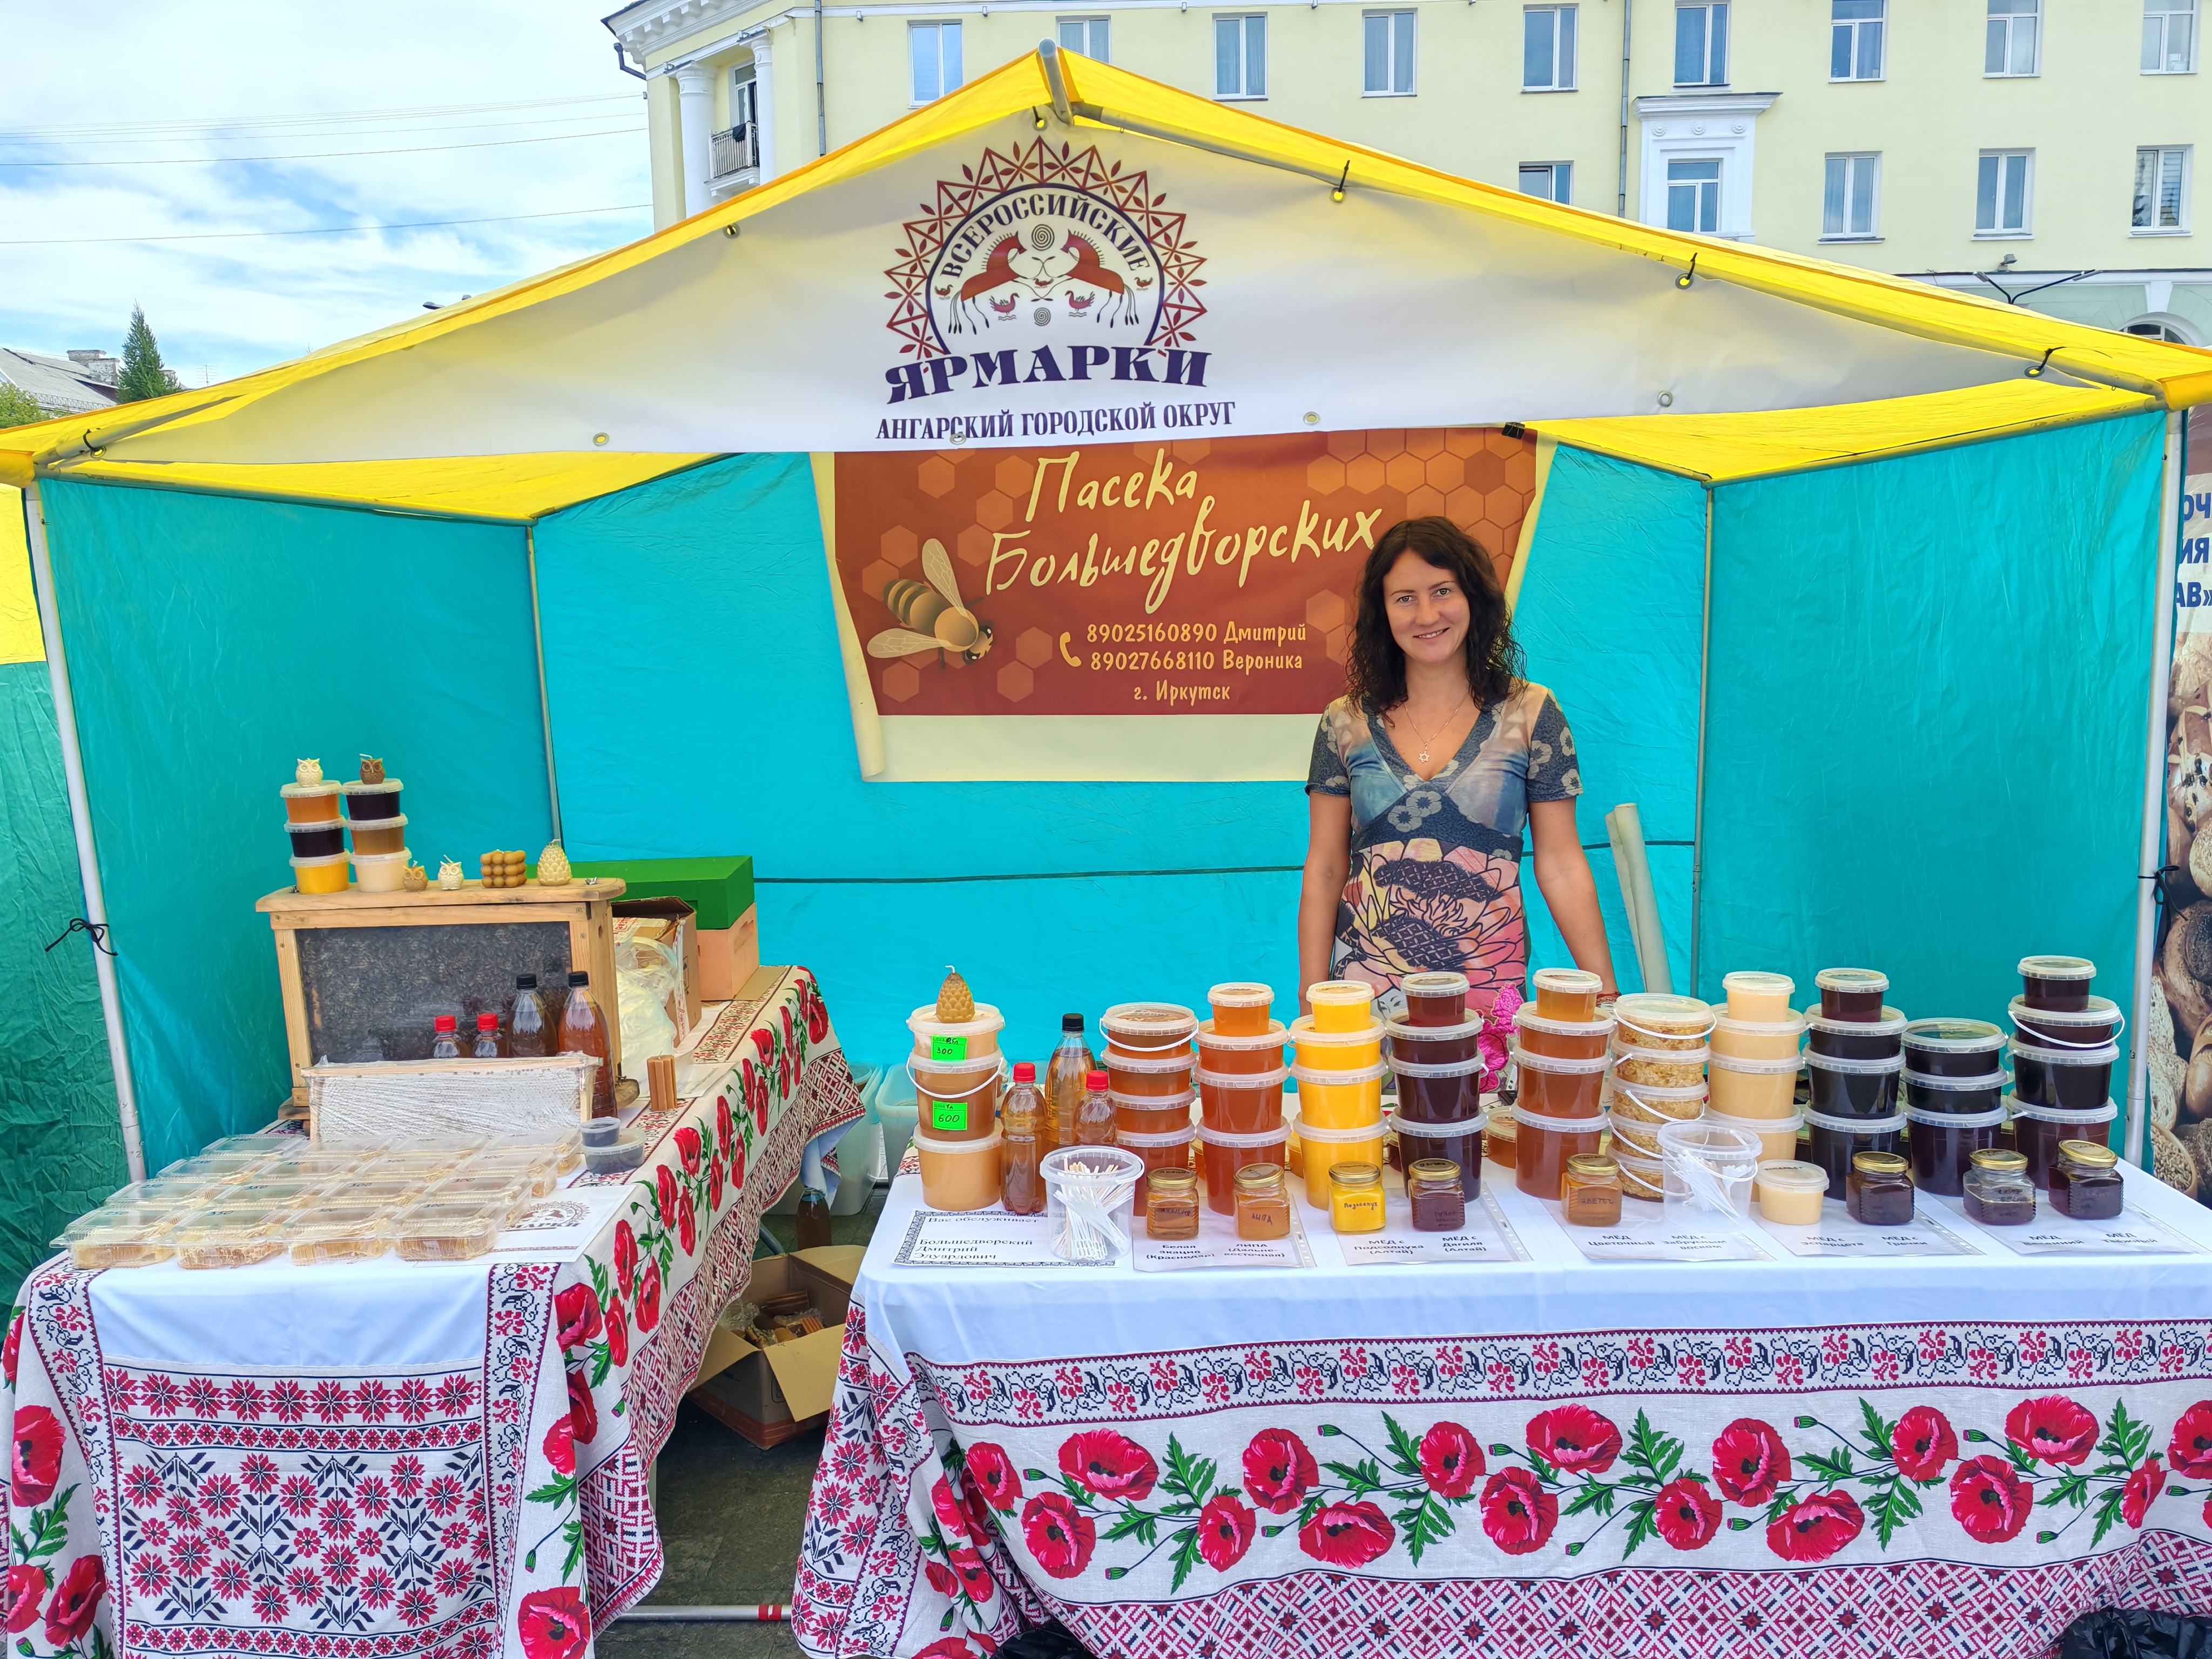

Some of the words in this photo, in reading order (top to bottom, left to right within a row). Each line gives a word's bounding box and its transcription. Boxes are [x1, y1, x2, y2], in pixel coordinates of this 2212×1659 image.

[939, 193, 1151, 279] ВСЕРОССИЙСКИЕ
[885, 343, 1212, 404] ЯРМАРКИ
[875, 408, 1014, 439] АНГАРСКИЙ
[1021, 401, 1157, 436] ГОРОДСКОЙ
[1163, 401, 1236, 429] ОКРУГ
[1025, 448, 1198, 522] Пасека
[985, 495, 1382, 614] Большедворских
[1087, 622, 1217, 643] 89025160890
[1223, 621, 1307, 647] Дмитрий
[1090, 651, 1215, 670] 89027668110
[1223, 649, 1303, 673] Вероника
[1134, 685, 1148, 701] г.
[1155, 680, 1231, 706] Иркутск
[936, 1047, 953, 1055] 300
[939, 1114, 960, 1122] 600
